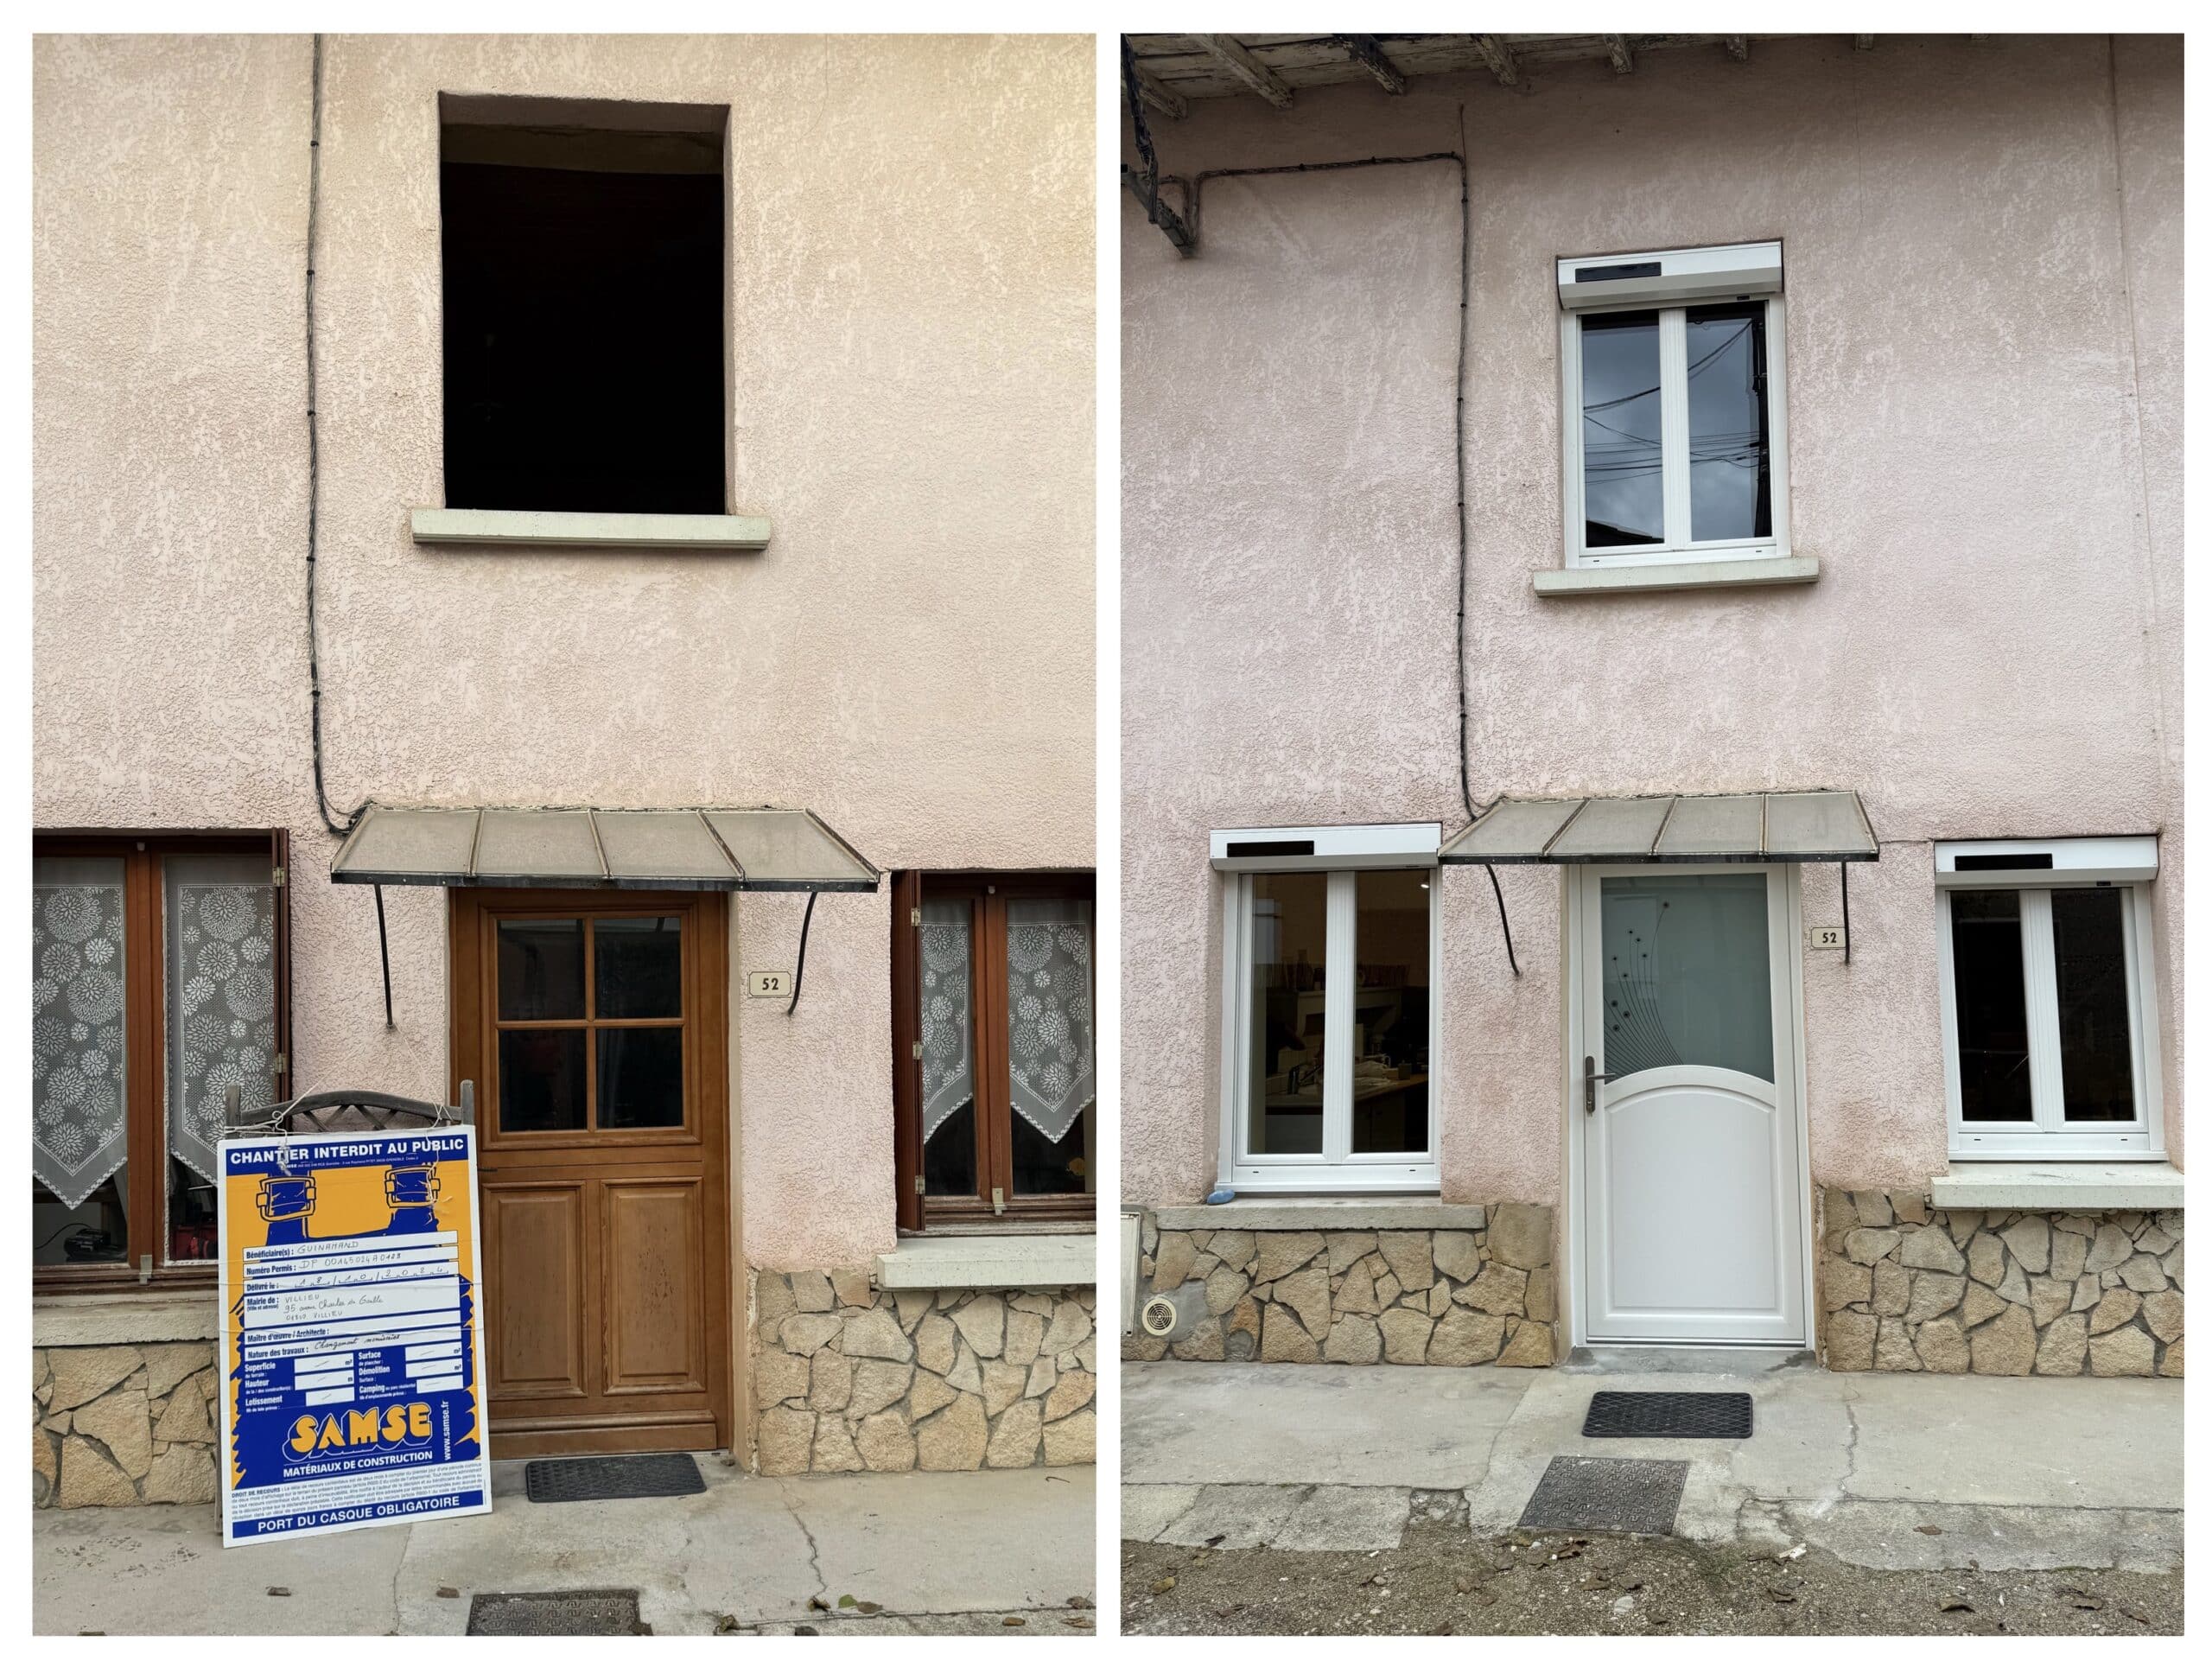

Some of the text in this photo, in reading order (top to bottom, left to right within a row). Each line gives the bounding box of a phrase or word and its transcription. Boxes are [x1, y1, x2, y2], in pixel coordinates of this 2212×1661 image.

[1822, 932, 1837, 944] 52
[762, 977, 779, 990] 52
[314, 1143, 382, 1159] INTERDIT
[387, 1142, 407, 1154] AU
[412, 1138, 464, 1152] PUBLIC
[246, 1249, 290, 1259] Bénéficiaire(s)
[246, 1267, 270, 1276] Numéro
[247, 1297, 267, 1306] Mairie
[296, 1328, 326, 1337] Architecte
[359, 1351, 381, 1359] Surface
[245, 1362, 276, 1372] Superficie
[359, 1365, 390, 1376] Démolition
[245, 1379, 270, 1388] Hauteur
[359, 1384, 385, 1393] Camping
[245, 1395, 283, 1406] Lotissement
[288, 1403, 431, 1454] SAMSE
[441, 1400, 451, 1461] www.samse.fr
[283, 1451, 433, 1478] MATÉRIAUX DE CONSTRUCTION
[256, 1486, 280, 1495] RECOURS
[258, 1518, 293, 1532] PORT
[297, 1515, 315, 1527] DU
[320, 1507, 373, 1524] CASQUE
[377, 1496, 460, 1516] OBLIGATOIRE
